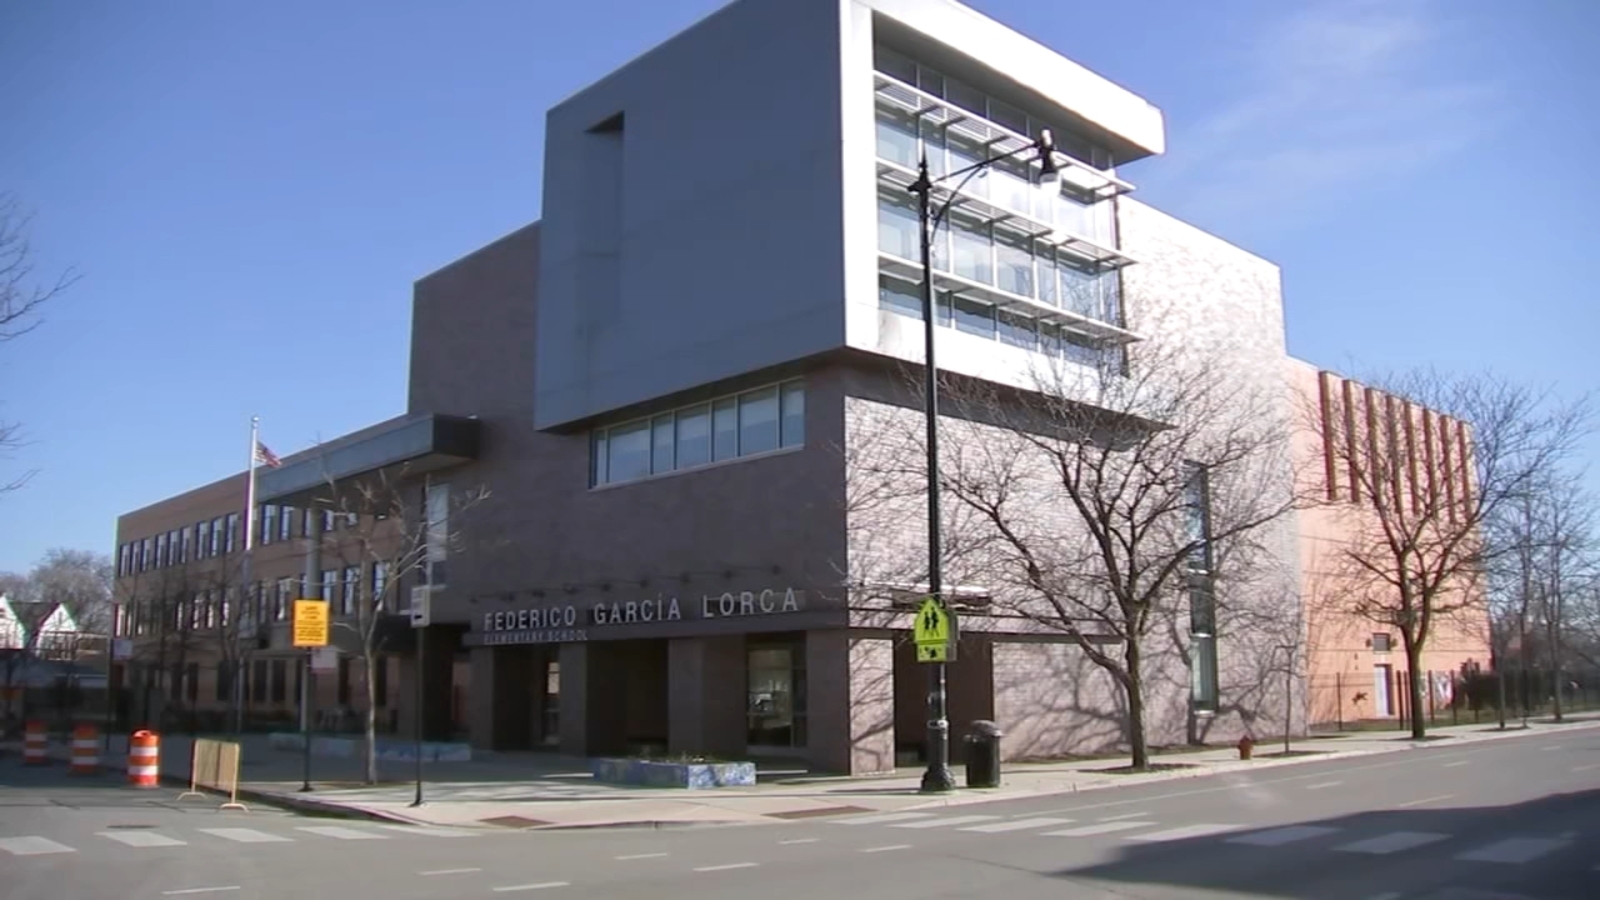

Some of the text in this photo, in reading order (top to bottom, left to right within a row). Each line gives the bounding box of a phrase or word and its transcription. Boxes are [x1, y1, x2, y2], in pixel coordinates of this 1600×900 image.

[484, 587, 798, 631] FEDERICO GARCÍA LORCA
[547, 629, 588, 642] SCHOOL
